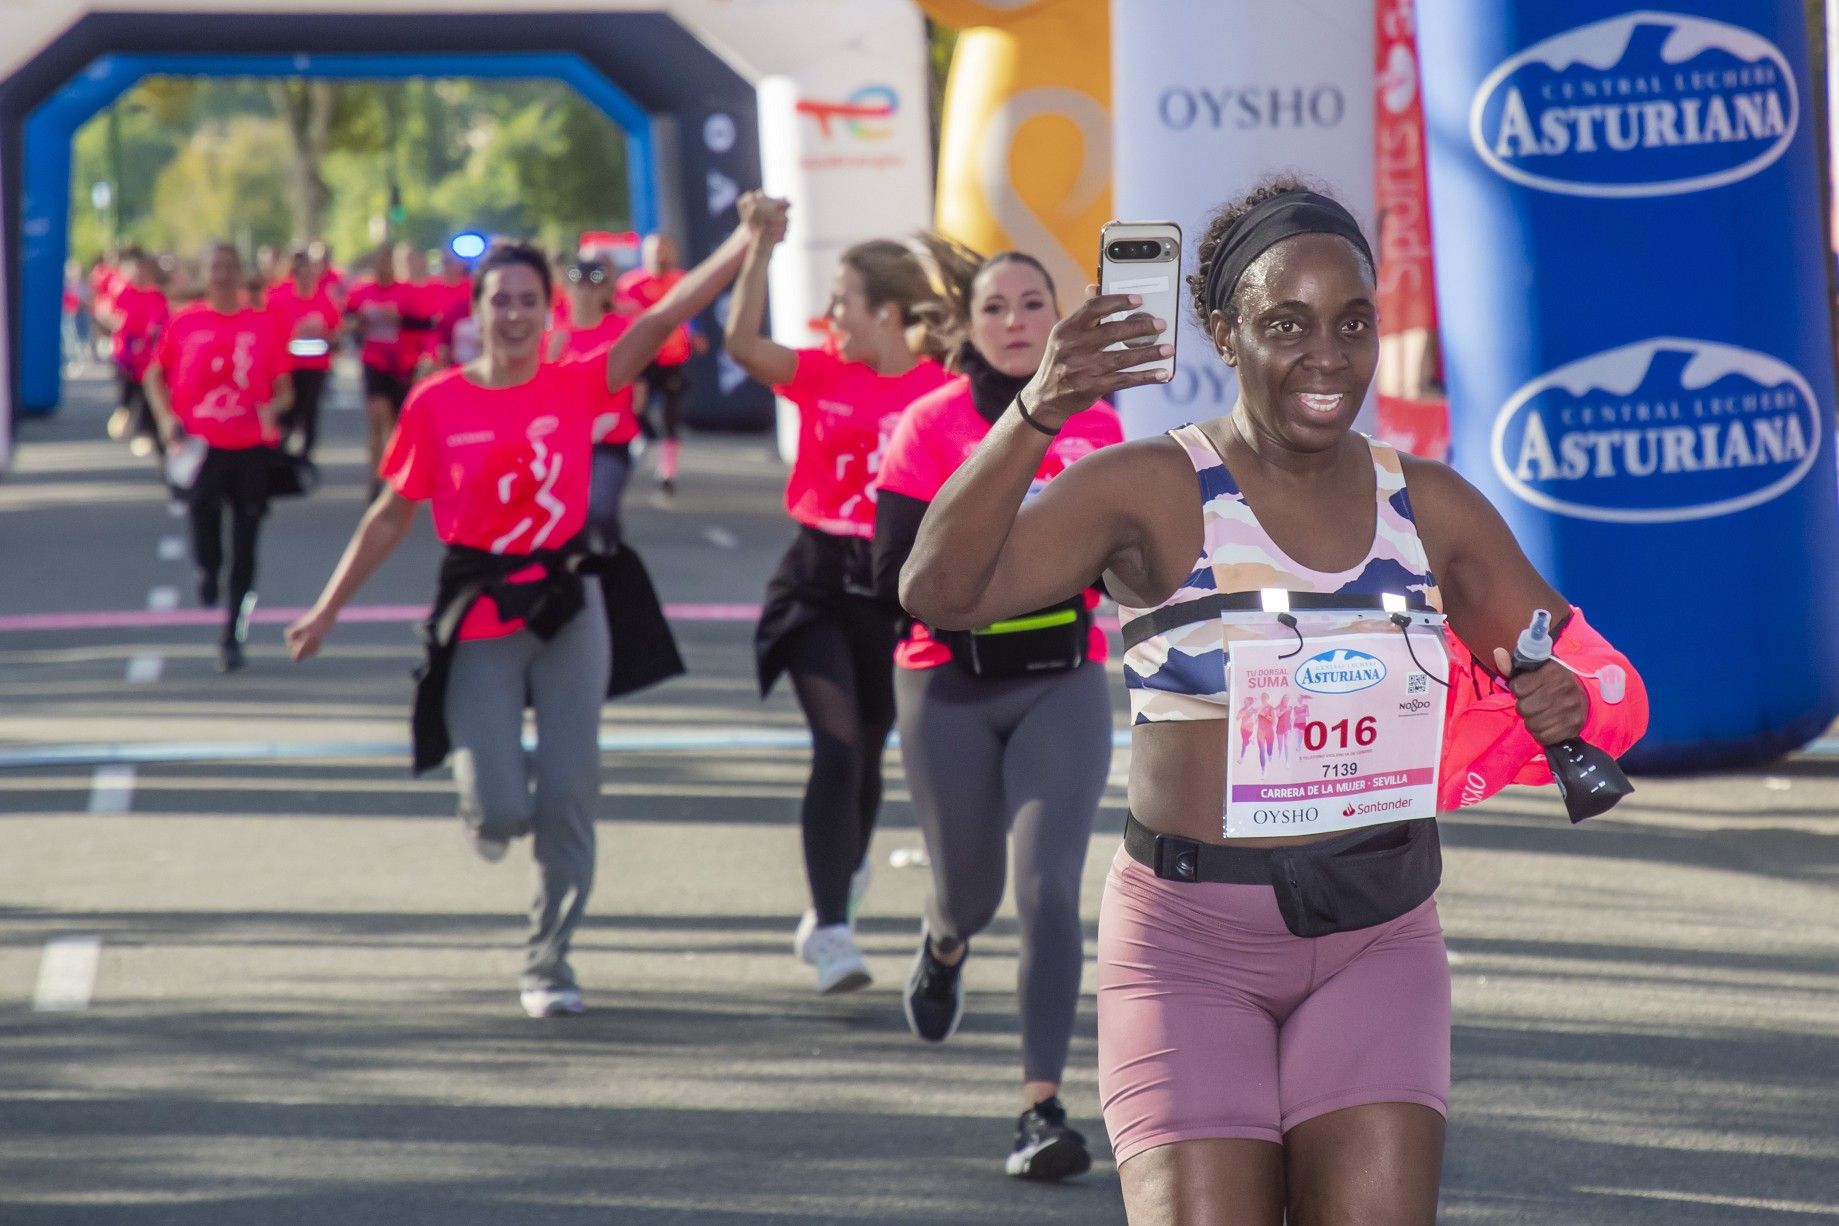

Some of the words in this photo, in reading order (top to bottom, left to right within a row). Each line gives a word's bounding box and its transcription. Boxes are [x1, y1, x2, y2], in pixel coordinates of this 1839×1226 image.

[1158, 84, 1346, 131] OYSHO
[1495, 85, 1787, 158] ASTURIANA
[1515, 408, 1808, 482] ASTURIANA
[1248, 676, 1289, 689] SUMA
[1258, 668, 1288, 677] DORSAL
[1302, 667, 1380, 685] ASTURIANA
[1303, 715, 1377, 751] 016
[1322, 762, 1358, 778] 7139
[1260, 786, 1305, 799] CARRERA
[1307, 785, 1319, 796] DE
[1321, 783, 1334, 794] LA
[1336, 780, 1366, 793] MUJER
[1372, 774, 1408, 787] SEVILLA
[1253, 807, 1319, 825] OYSHO
[1357, 798, 1413, 815] Santander
